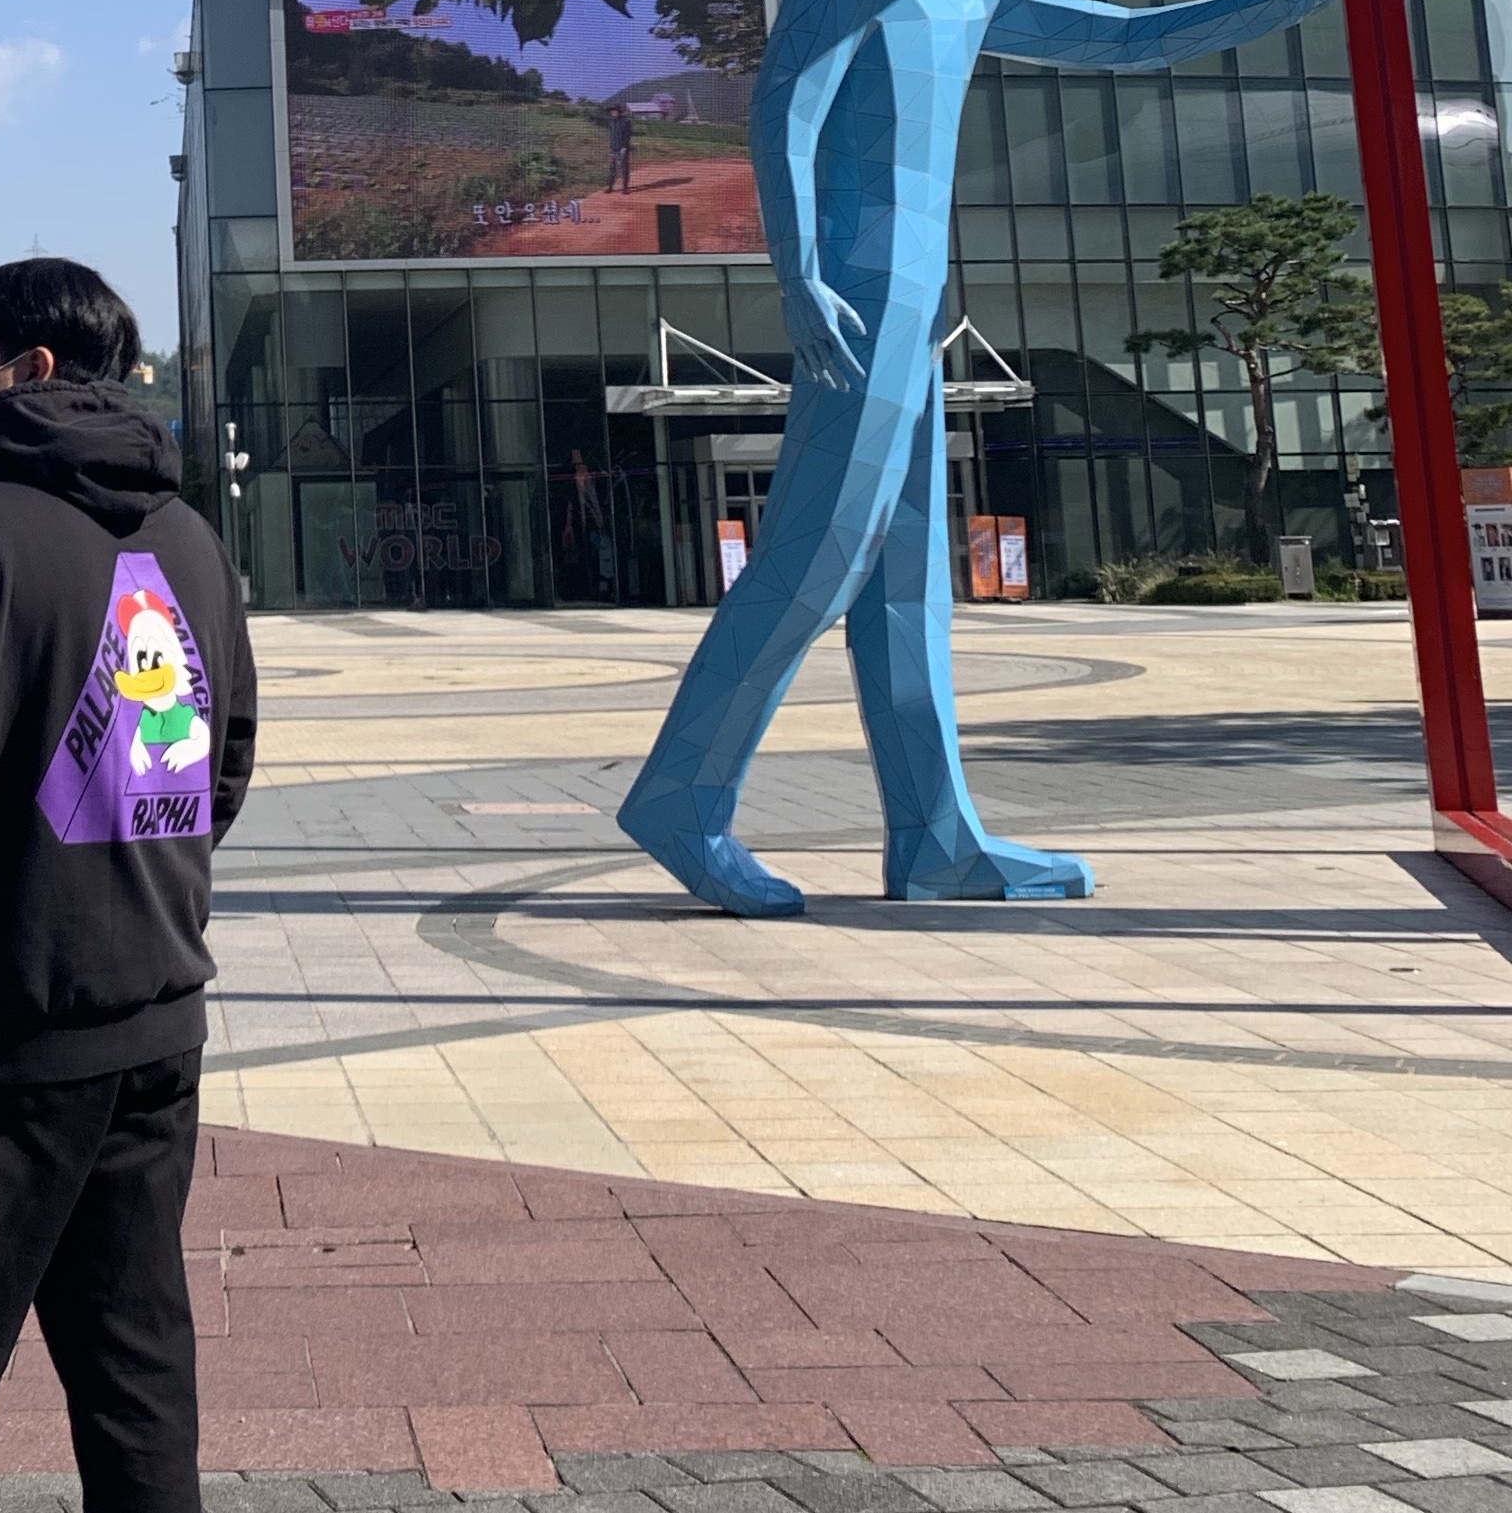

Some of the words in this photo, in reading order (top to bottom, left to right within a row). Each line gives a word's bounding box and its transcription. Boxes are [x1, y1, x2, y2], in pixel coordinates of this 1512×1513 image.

[494, 199, 515, 225] 안
[375, 501, 459, 531] MBC
[338, 533, 503, 572] WORLD
[64, 620, 127, 776] PALACE
[130, 795, 201, 837] RAPHA
